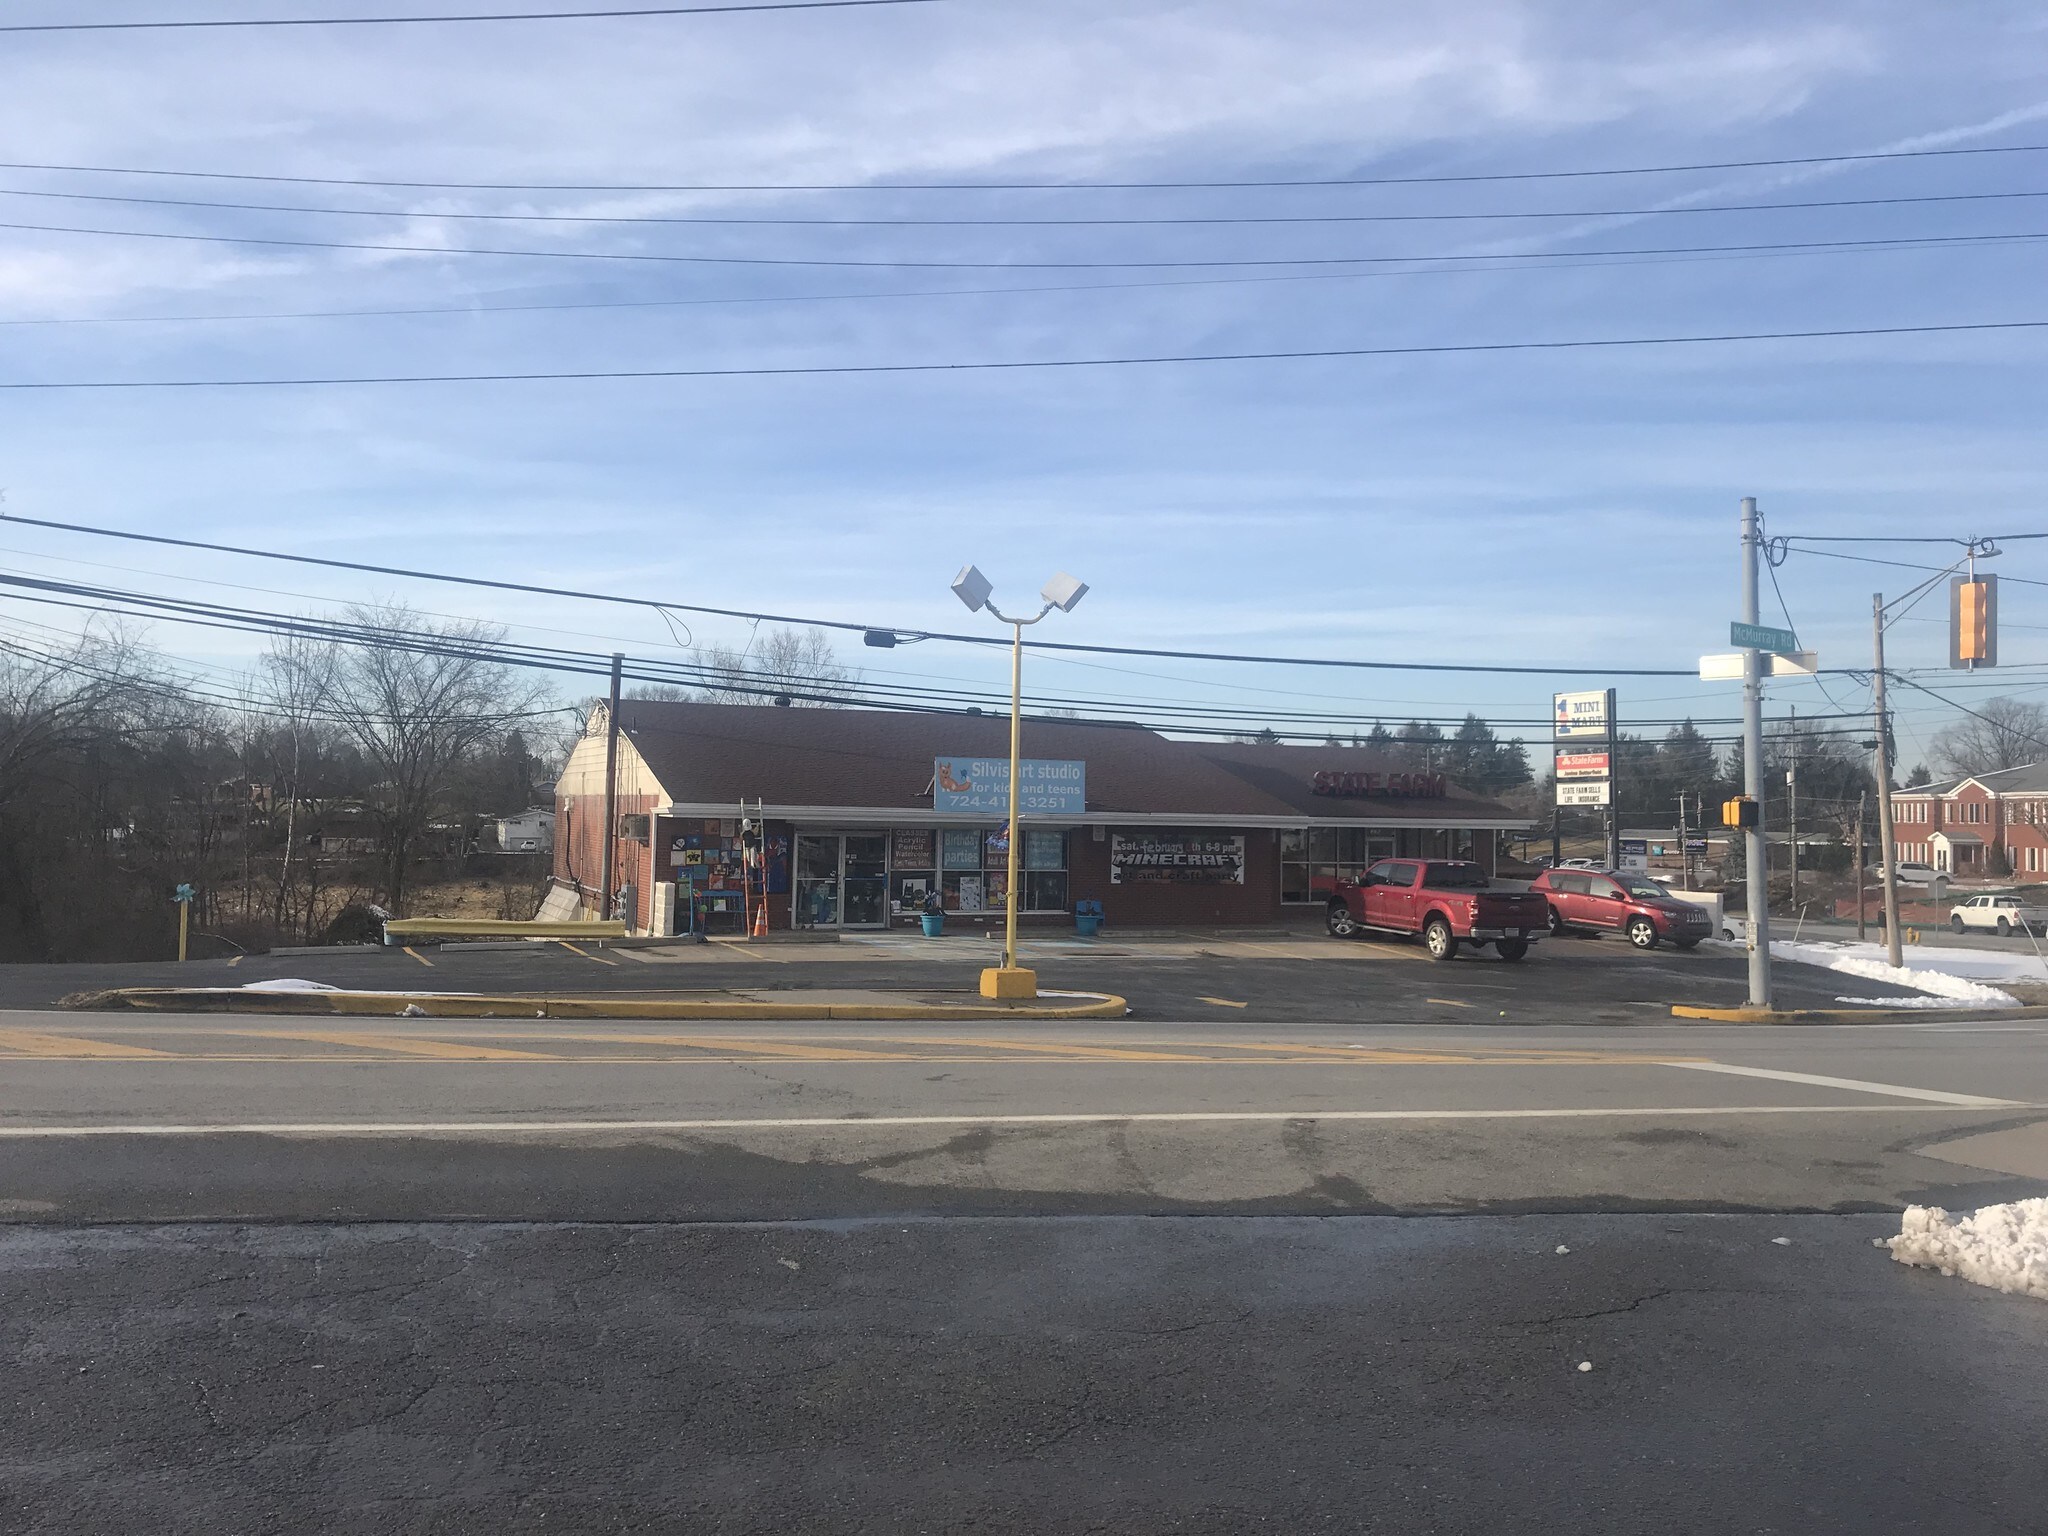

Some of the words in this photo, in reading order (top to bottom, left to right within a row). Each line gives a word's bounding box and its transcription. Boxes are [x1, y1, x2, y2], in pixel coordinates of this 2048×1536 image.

[1734, 626, 1776, 648] McMurray
[1781, 633, 1792, 647] Rd
[1573, 701, 1600, 713] MINI
[1571, 716, 1603, 728] MART
[1038, 764, 1080, 779] studio
[972, 782, 989, 793] for
[1022, 783, 1044, 794] and
[1048, 784, 1081, 795] teens
[1313, 771, 1381, 796] STATE
[1387, 772, 1447, 796] FARM
[950, 795, 1066, 808] 724-41-3251
[944, 832, 979, 849] Birthday
[1120, 841, 1139, 851] sat.
[1205, 842, 1220, 852] 6-8
[944, 850, 979, 866] parties
[1112, 853, 1243, 866] MINECRAFT
